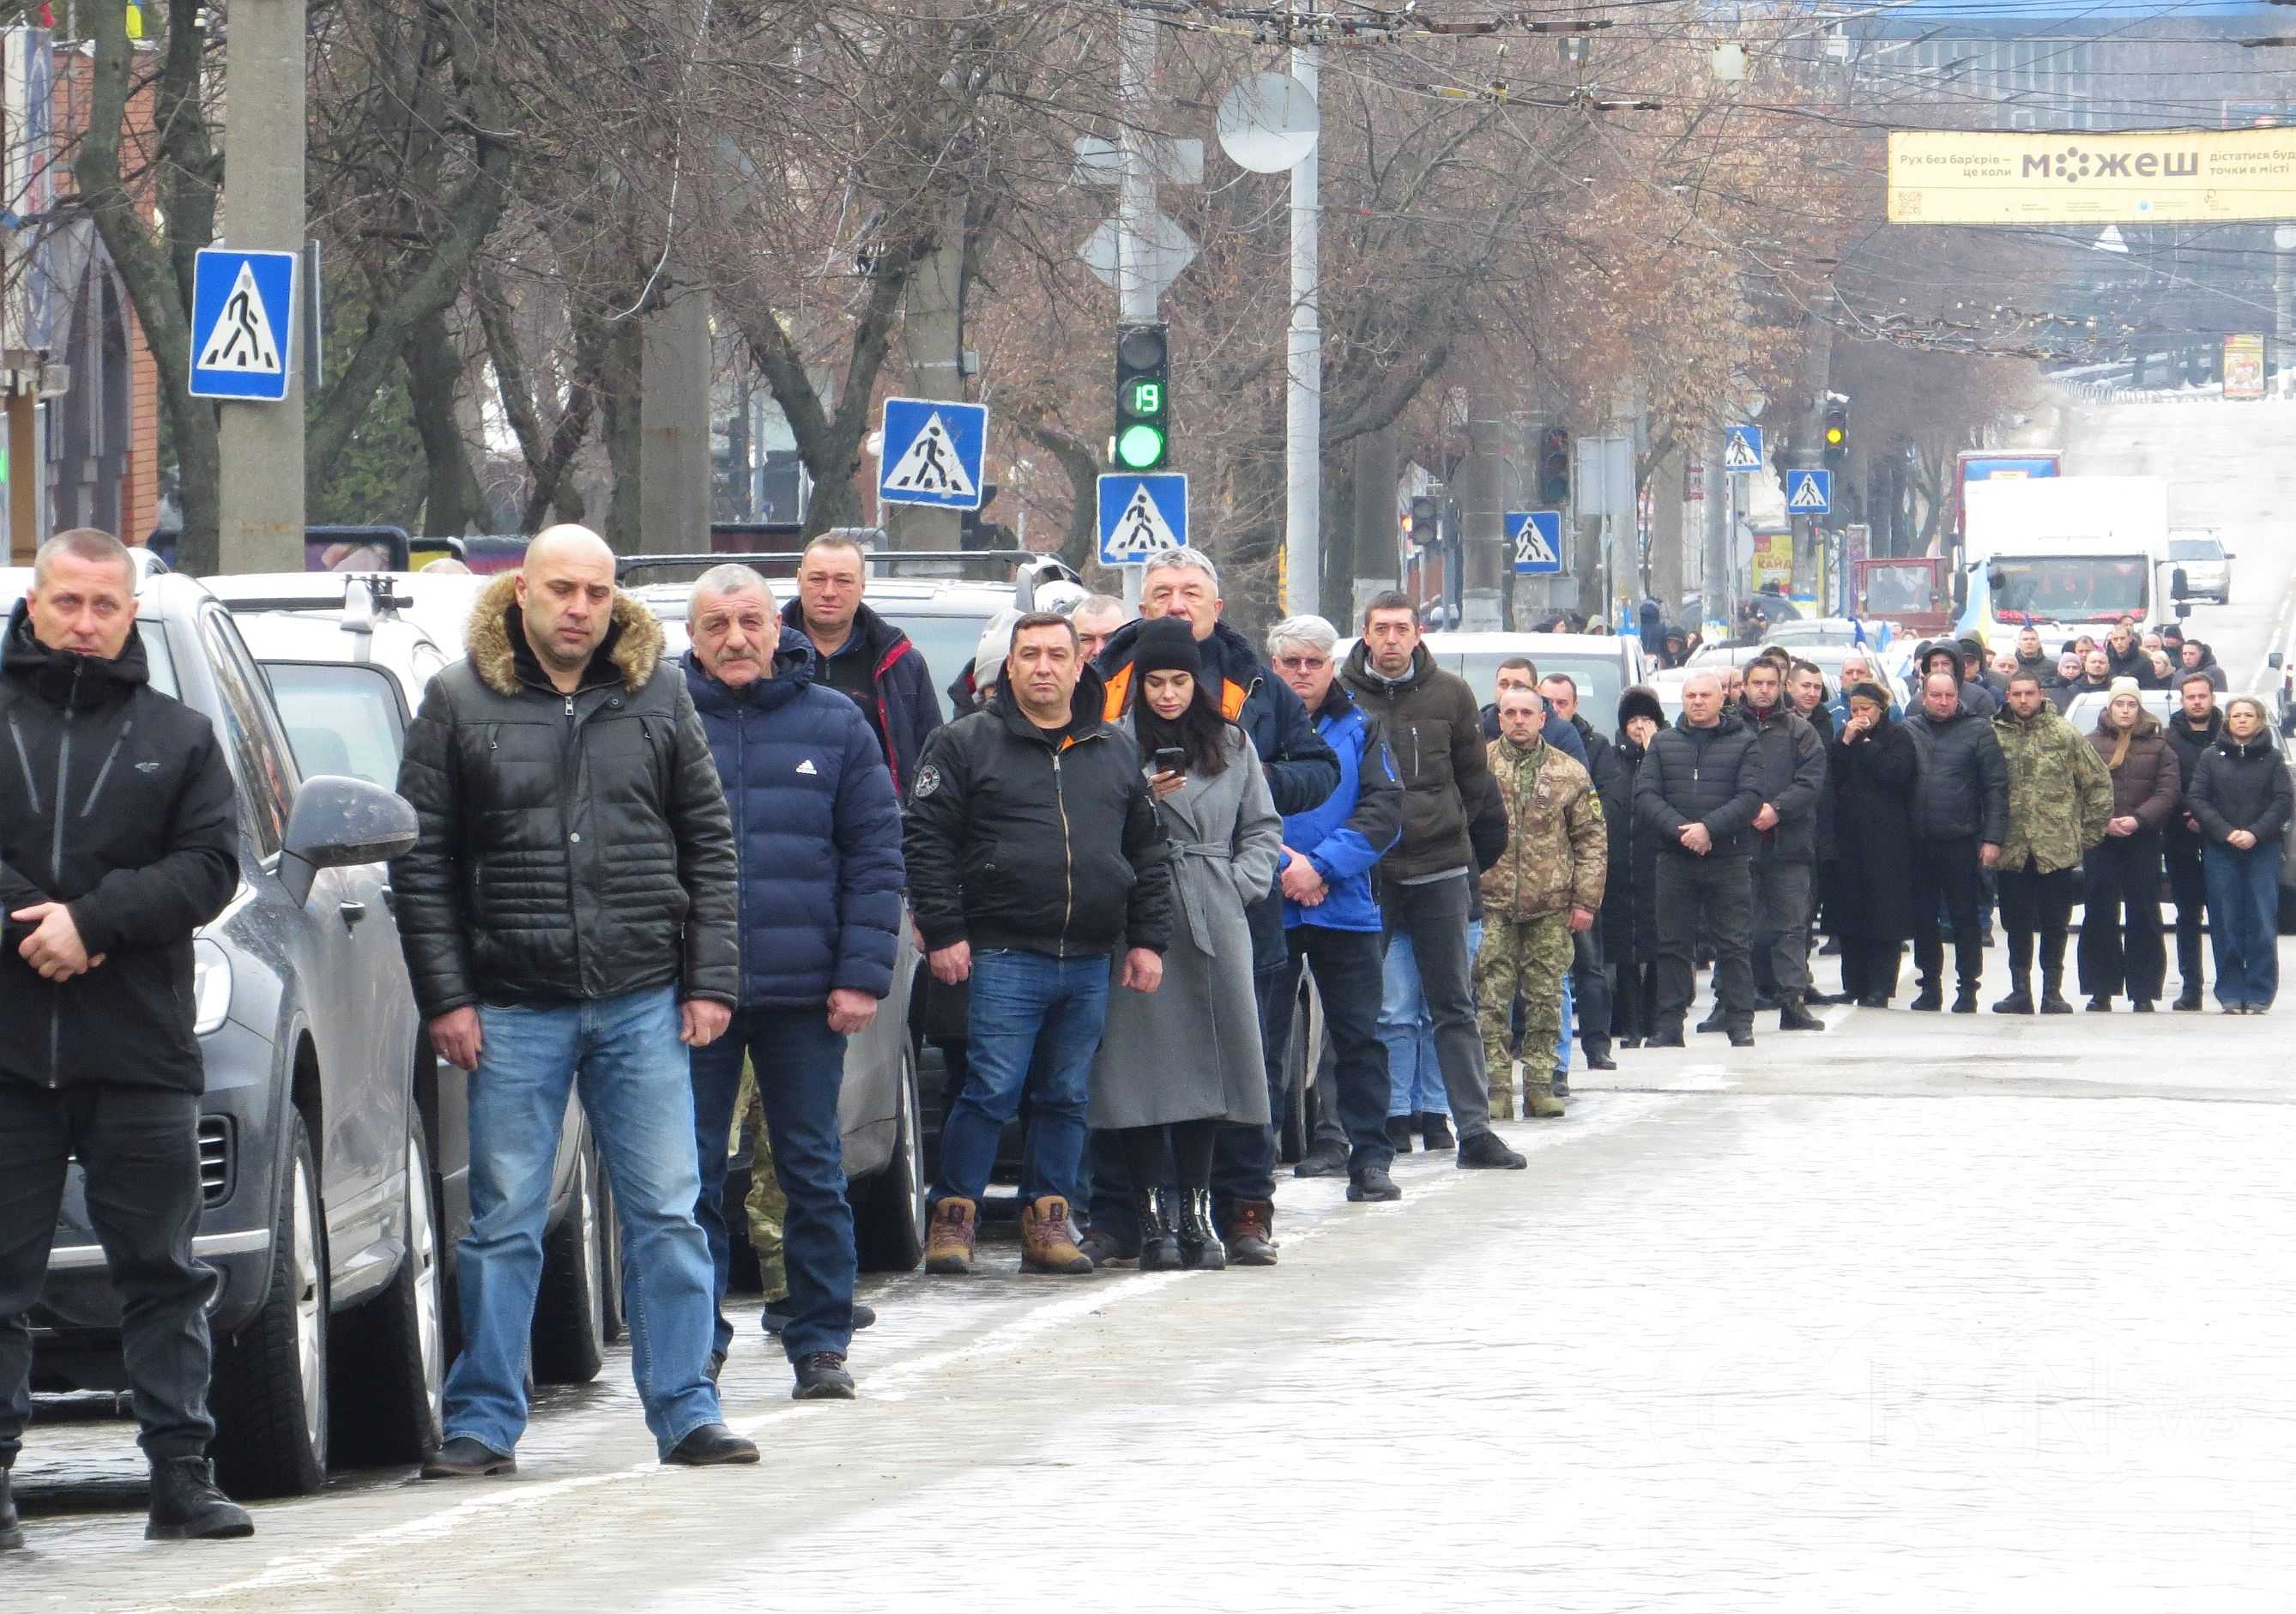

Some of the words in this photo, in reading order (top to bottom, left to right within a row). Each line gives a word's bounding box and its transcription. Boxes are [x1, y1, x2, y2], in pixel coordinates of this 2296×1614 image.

[1900, 154, 1923, 166] Рух
[1925, 154, 1947, 164] без
[2210, 150, 2270, 162] дістатися
[1963, 168, 1978, 178] це
[1981, 168, 2012, 177] коли
[2210, 166, 2247, 176] точки
[2259, 162, 2290, 174] місті
[1136, 384, 1158, 413] 19
